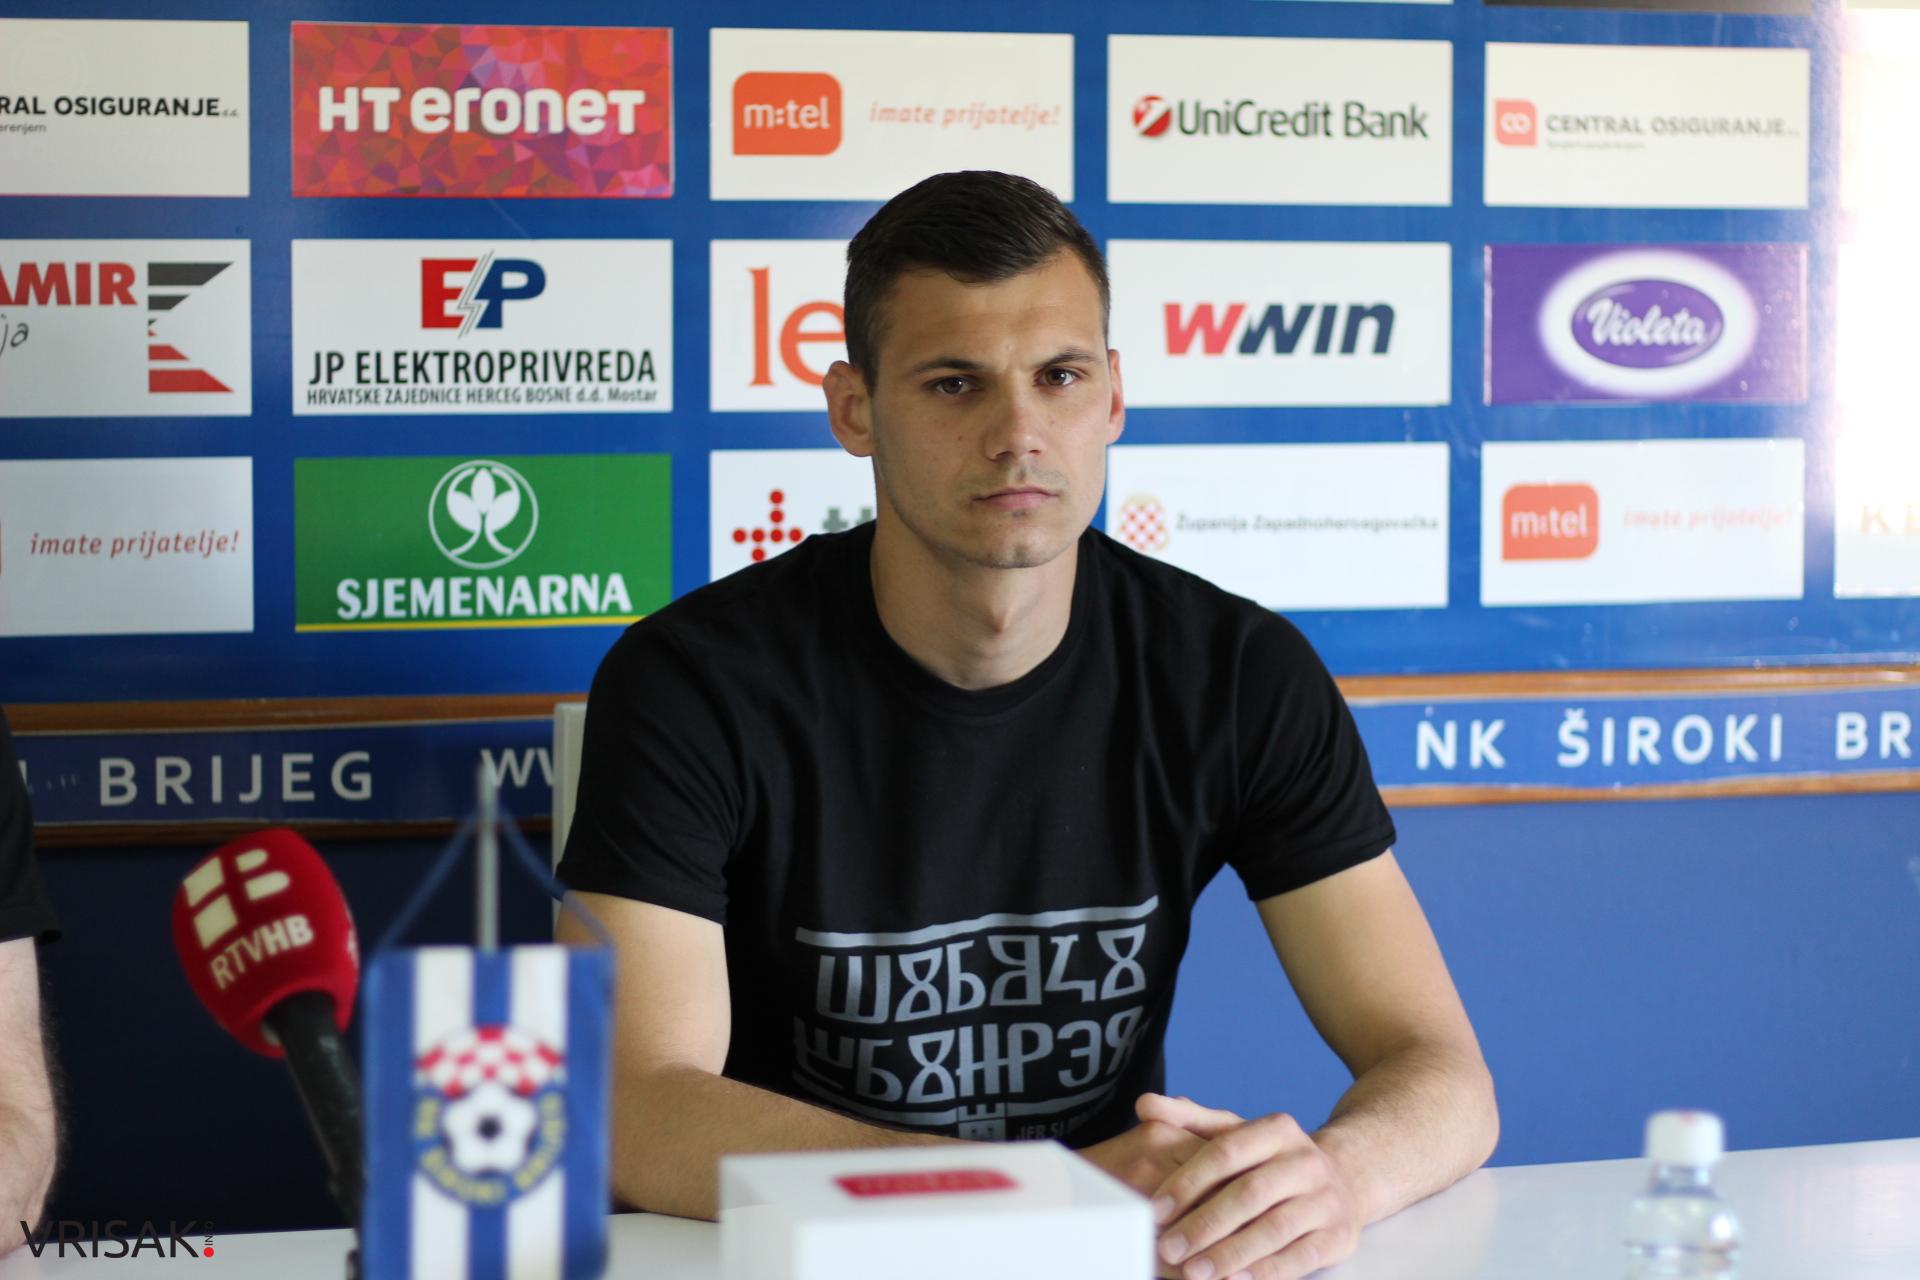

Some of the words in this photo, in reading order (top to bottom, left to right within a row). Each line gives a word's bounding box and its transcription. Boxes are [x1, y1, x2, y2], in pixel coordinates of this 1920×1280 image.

[54, 97, 220, 116] OSIGURANJE
[318, 86, 400, 133] HT
[743, 97, 830, 129] m:tel
[869, 101, 935, 124] imate
[942, 103, 1062, 131] prijatelje!
[1178, 100, 1331, 138] UniCredit
[1344, 101, 1429, 140] Bank
[1546, 114, 1644, 135] CENTRAL
[1651, 116, 1785, 136] OSIGURANJE
[1586, 298, 1706, 346] Violeta
[308, 350, 345, 386] JP
[356, 350, 656, 385] ELEKTROPRIVREDA
[307, 388, 380, 405] HRVATSKE
[385, 387, 462, 405] ZAJEDNICE
[466, 387, 521, 404] HERCEG
[526, 387, 571, 403] BOSNE
[608, 387, 658, 403] Mostar
[29, 533, 102, 556] imate
[110, 531, 240, 560] prijatelje!
[336, 574, 633, 621] SJEMENARNA
[1417, 719, 1506, 770] NK
[1558, 707, 1784, 769] ŠIROKI
[1836, 711, 1913, 760] BR
[100, 751, 374, 806] BRIJEG
[209, 915, 314, 990] RTVHB
